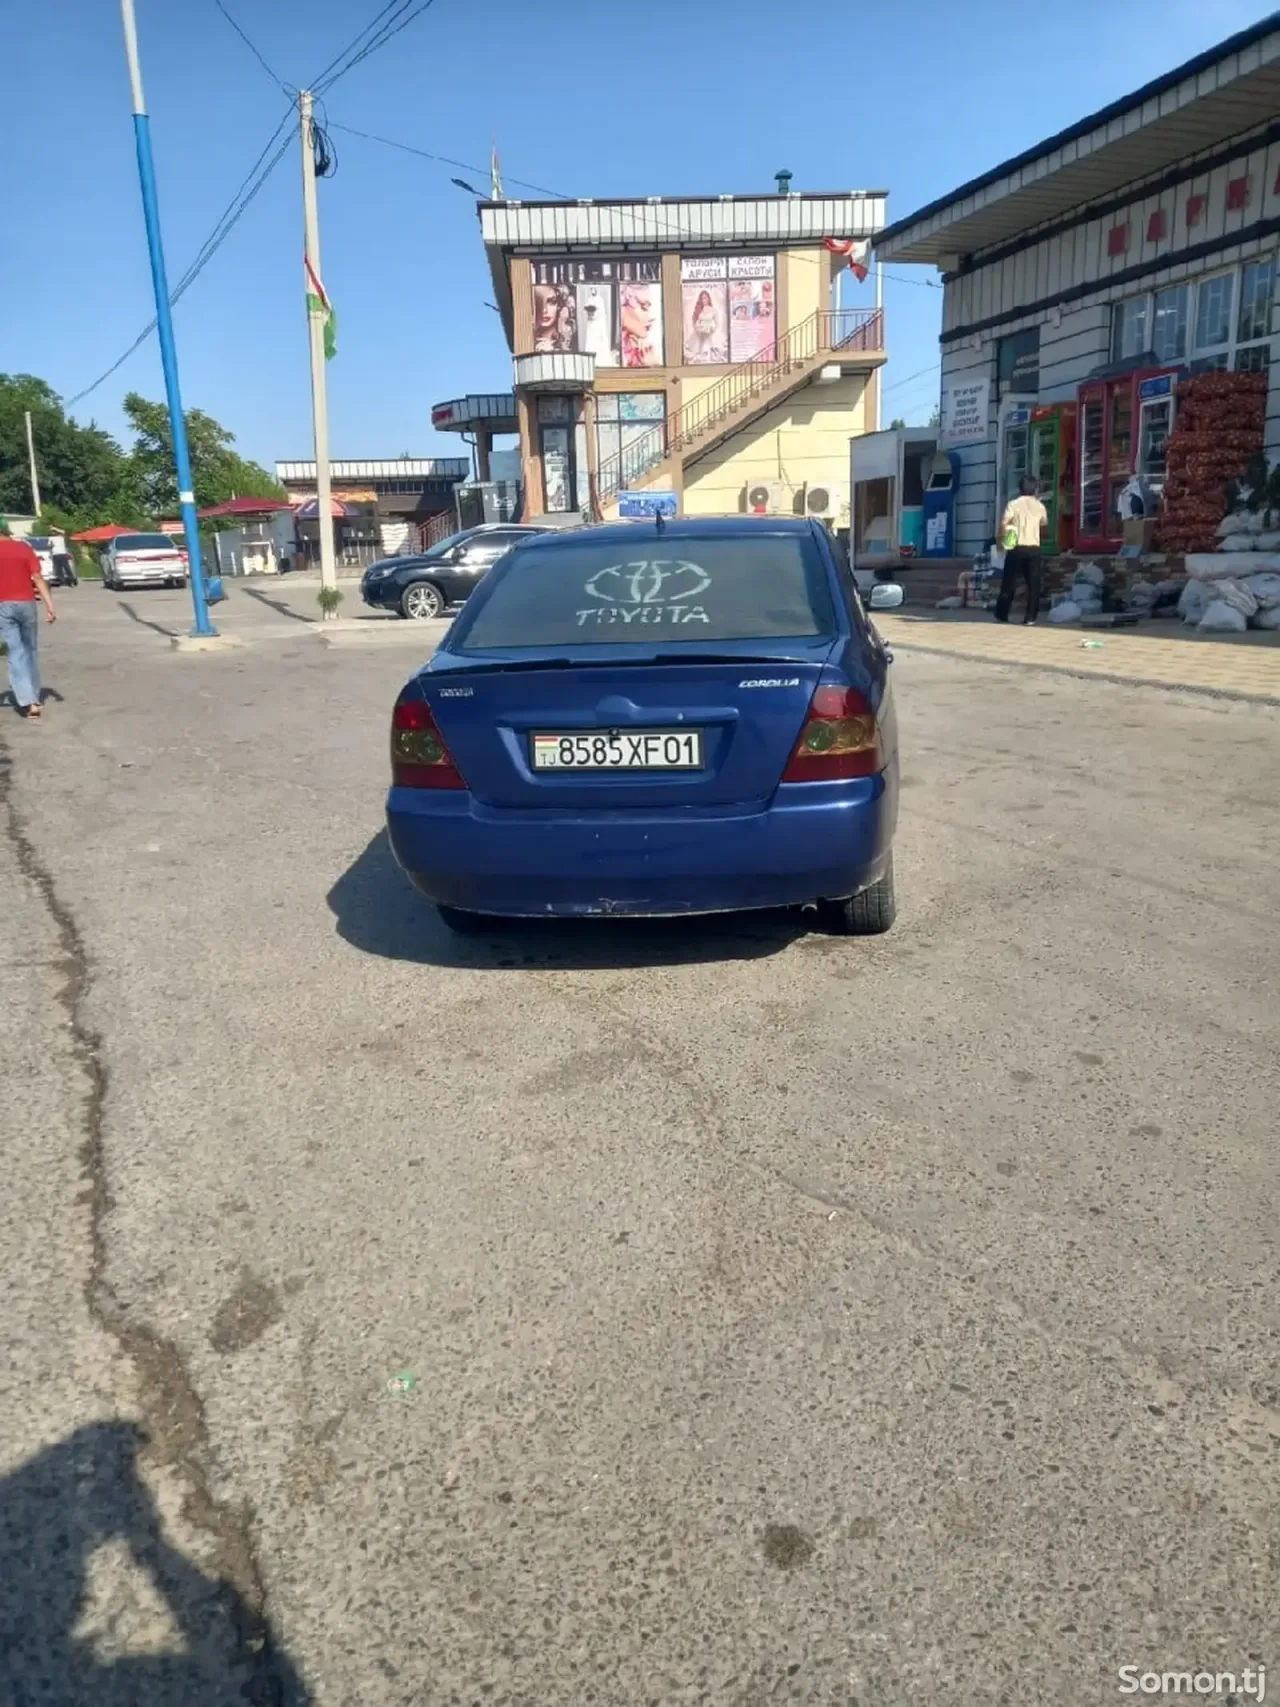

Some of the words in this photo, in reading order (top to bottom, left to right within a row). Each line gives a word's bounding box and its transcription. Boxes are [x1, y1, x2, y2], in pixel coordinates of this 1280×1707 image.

[731, 266, 772, 276] КРАСОТЫ
[576, 605, 710, 626] TOYOTA
[738, 678, 800, 688] COROLLA
[540, 754, 556, 765] TJ
